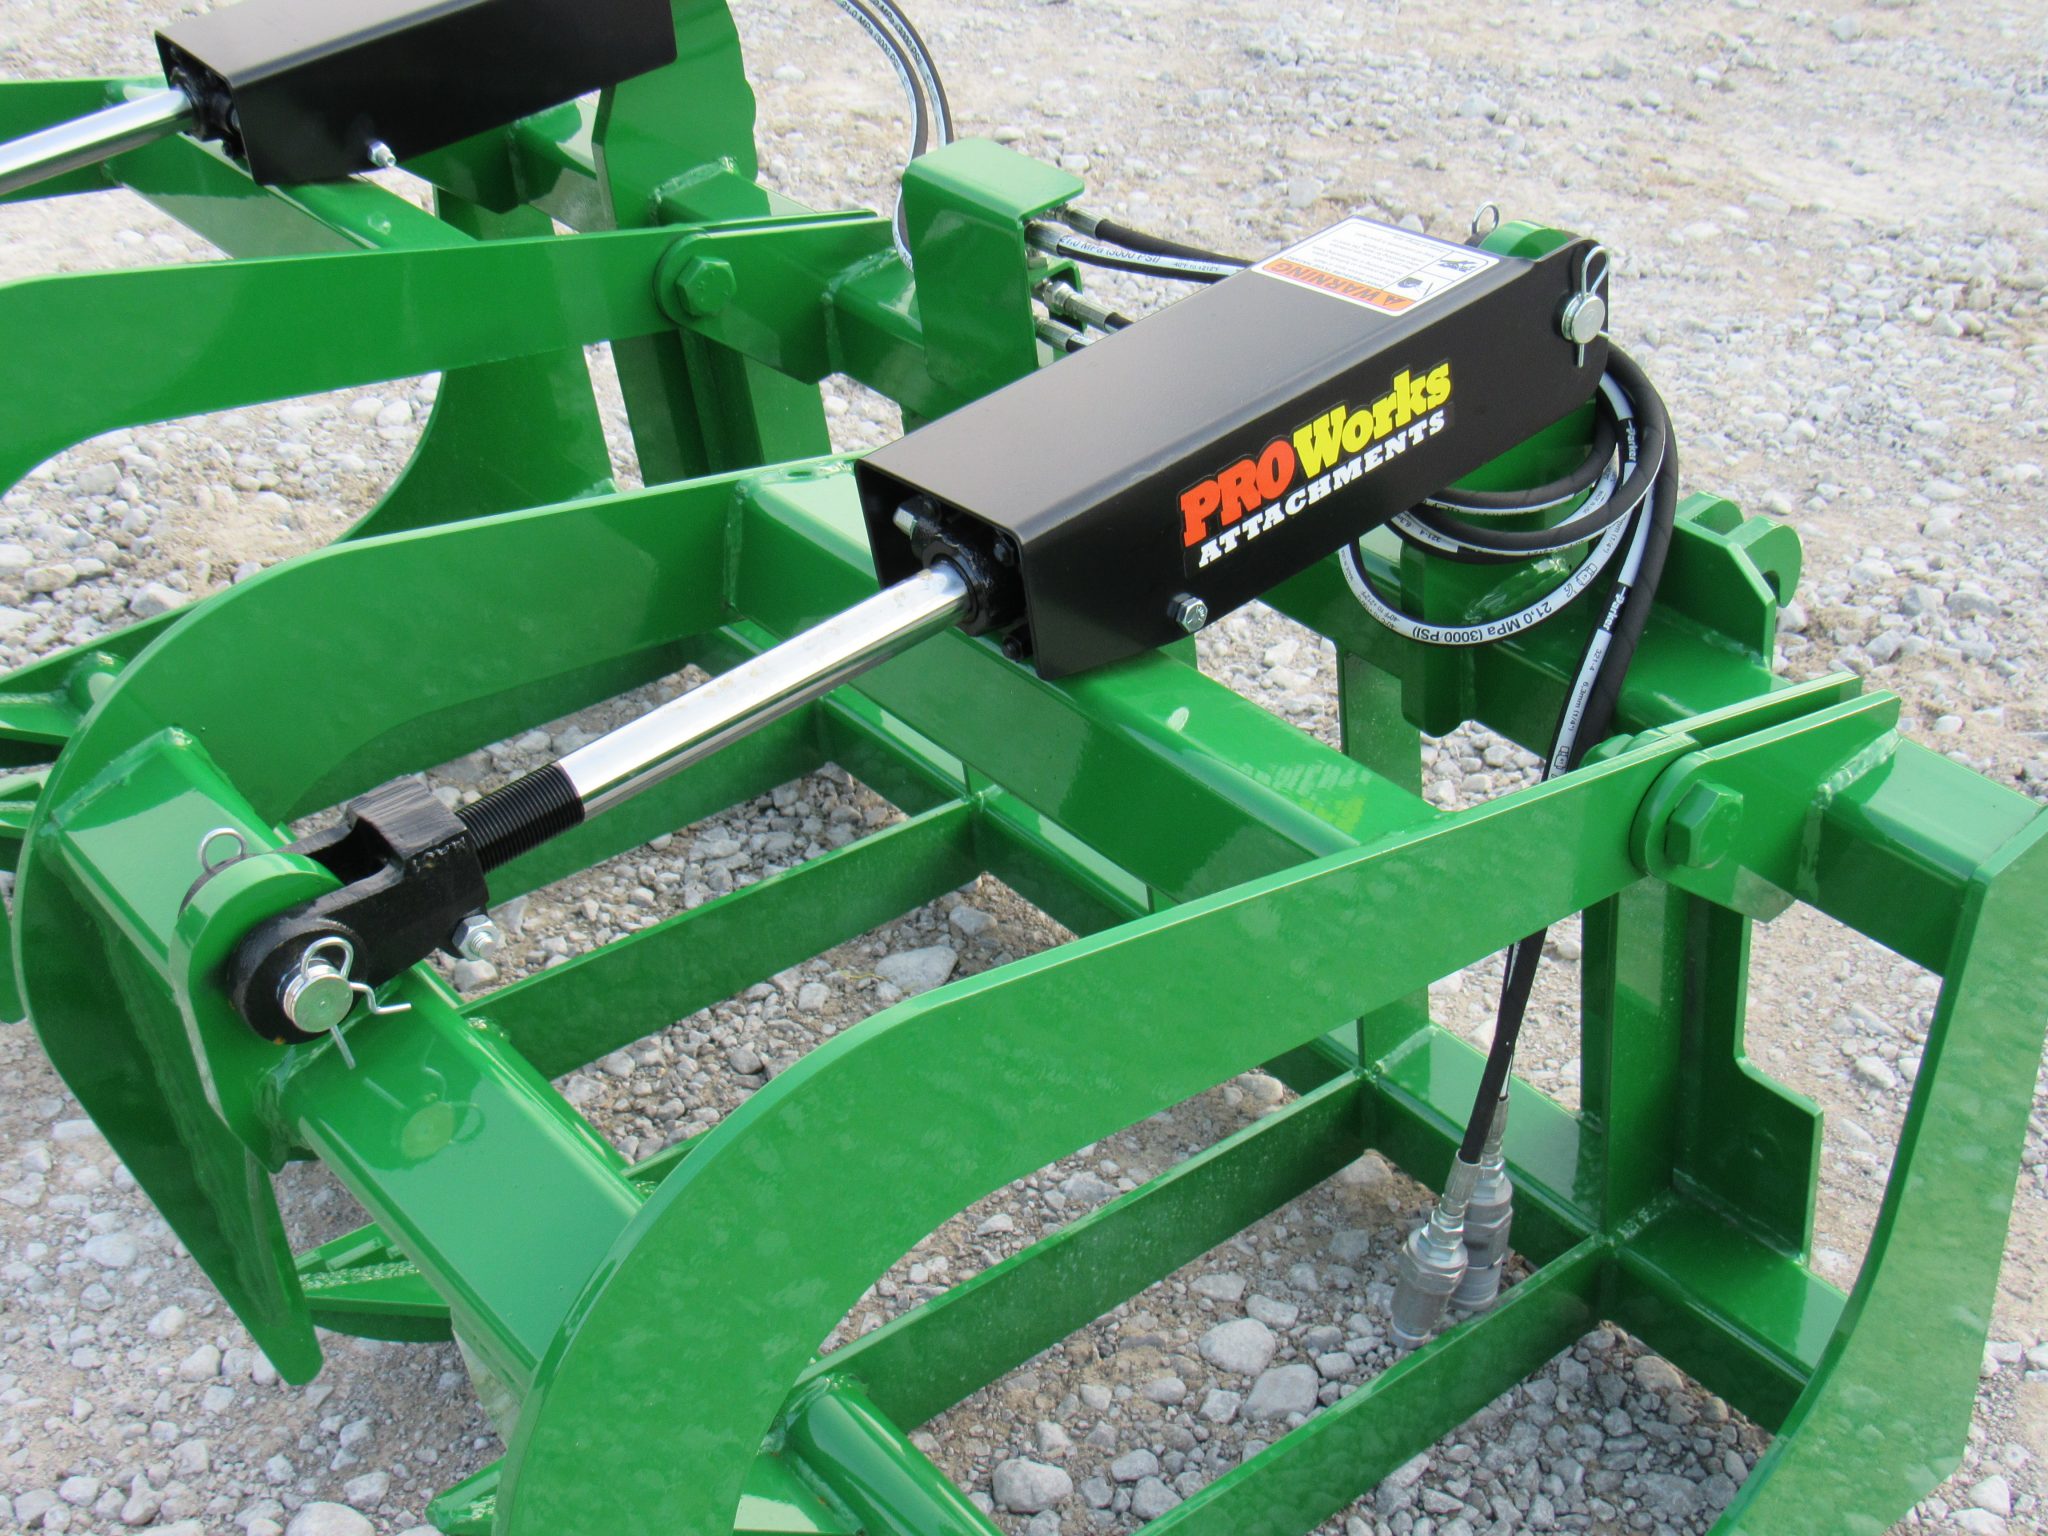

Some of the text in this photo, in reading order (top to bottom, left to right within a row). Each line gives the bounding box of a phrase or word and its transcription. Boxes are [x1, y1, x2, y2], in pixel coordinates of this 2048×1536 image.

[1271, 263, 1381, 301] WARNING
[1626, 420, 1638, 461] Parker
[1199, 410, 1444, 569] ATTACHMENTS
[1413, 601, 1552, 643] 21,0 MPa (3000 PSI)
[1603, 586, 1626, 631] Parker
